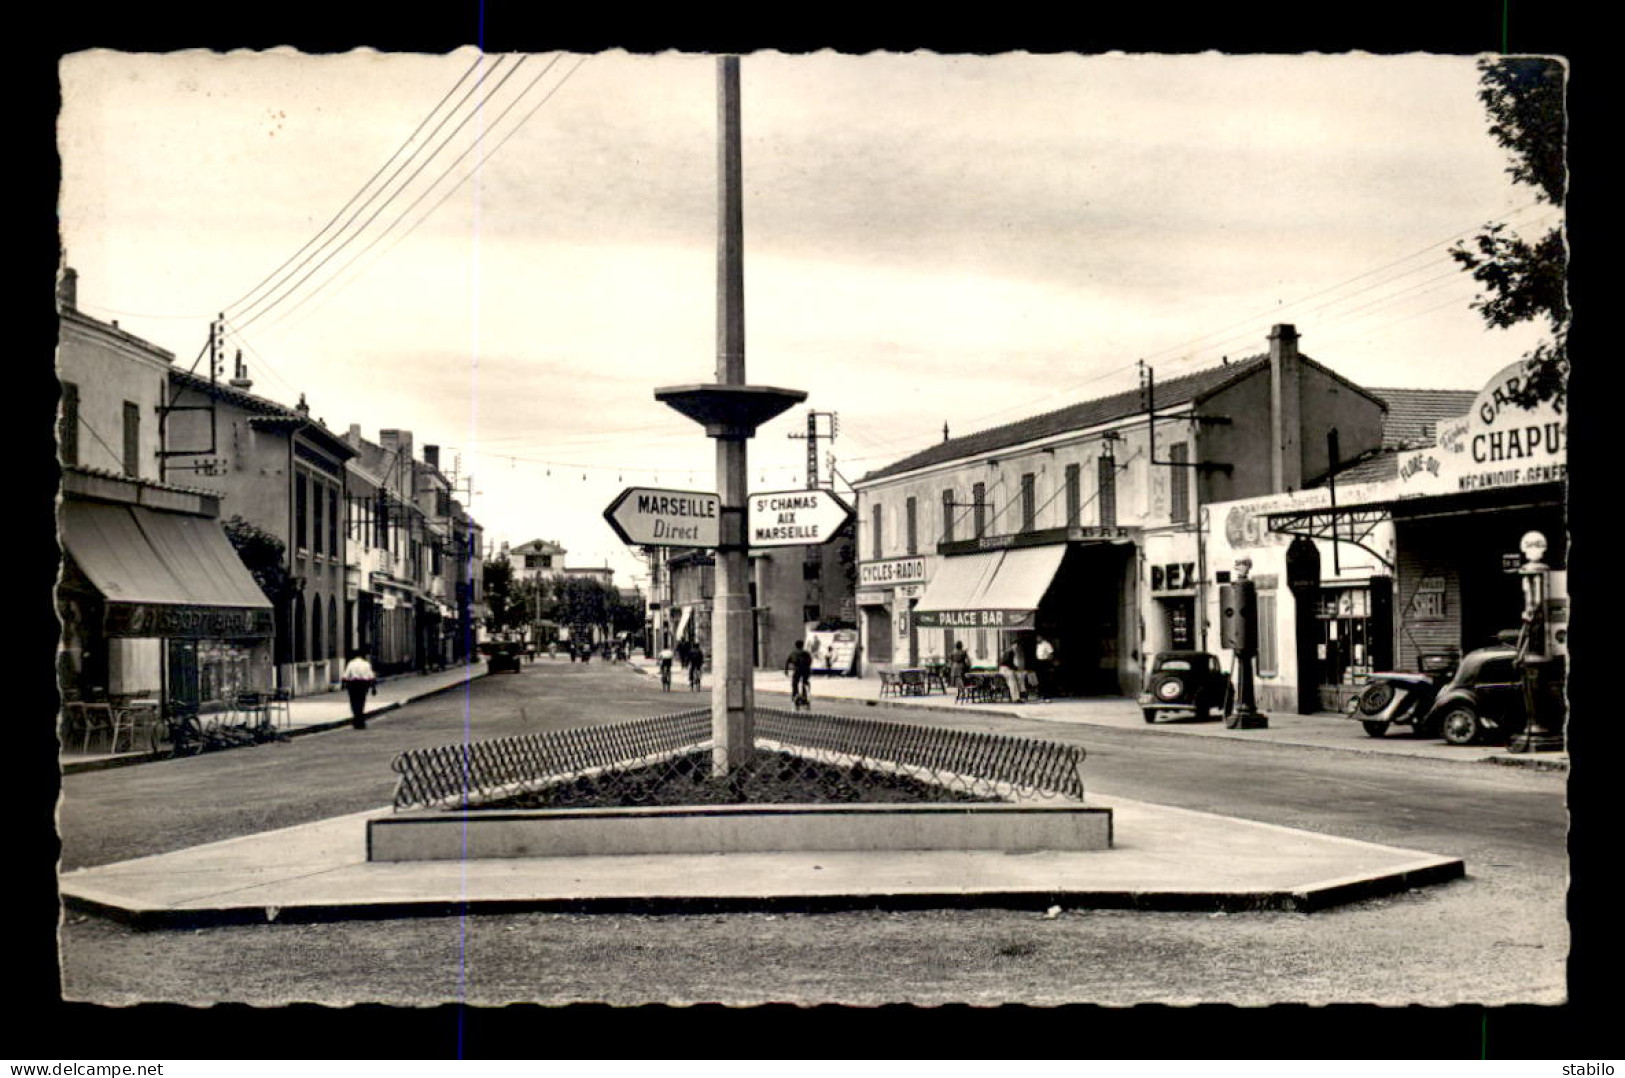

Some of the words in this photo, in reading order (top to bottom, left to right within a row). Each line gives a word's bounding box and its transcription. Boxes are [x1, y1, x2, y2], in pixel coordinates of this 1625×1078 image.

[638, 495, 715, 518] MARSEILLE
[770, 496, 818, 511] CHAMAS
[777, 512, 796, 524] AIX
[653, 518, 698, 539] Direct
[755, 525, 818, 540] MARSEILLE
[1082, 527, 1128, 537] BAR
[863, 561, 922, 581] CYCLES-RADIO
[1151, 563, 1195, 591] REX
[939, 611, 976, 626] PALACE
[982, 611, 1003, 625] BAR
